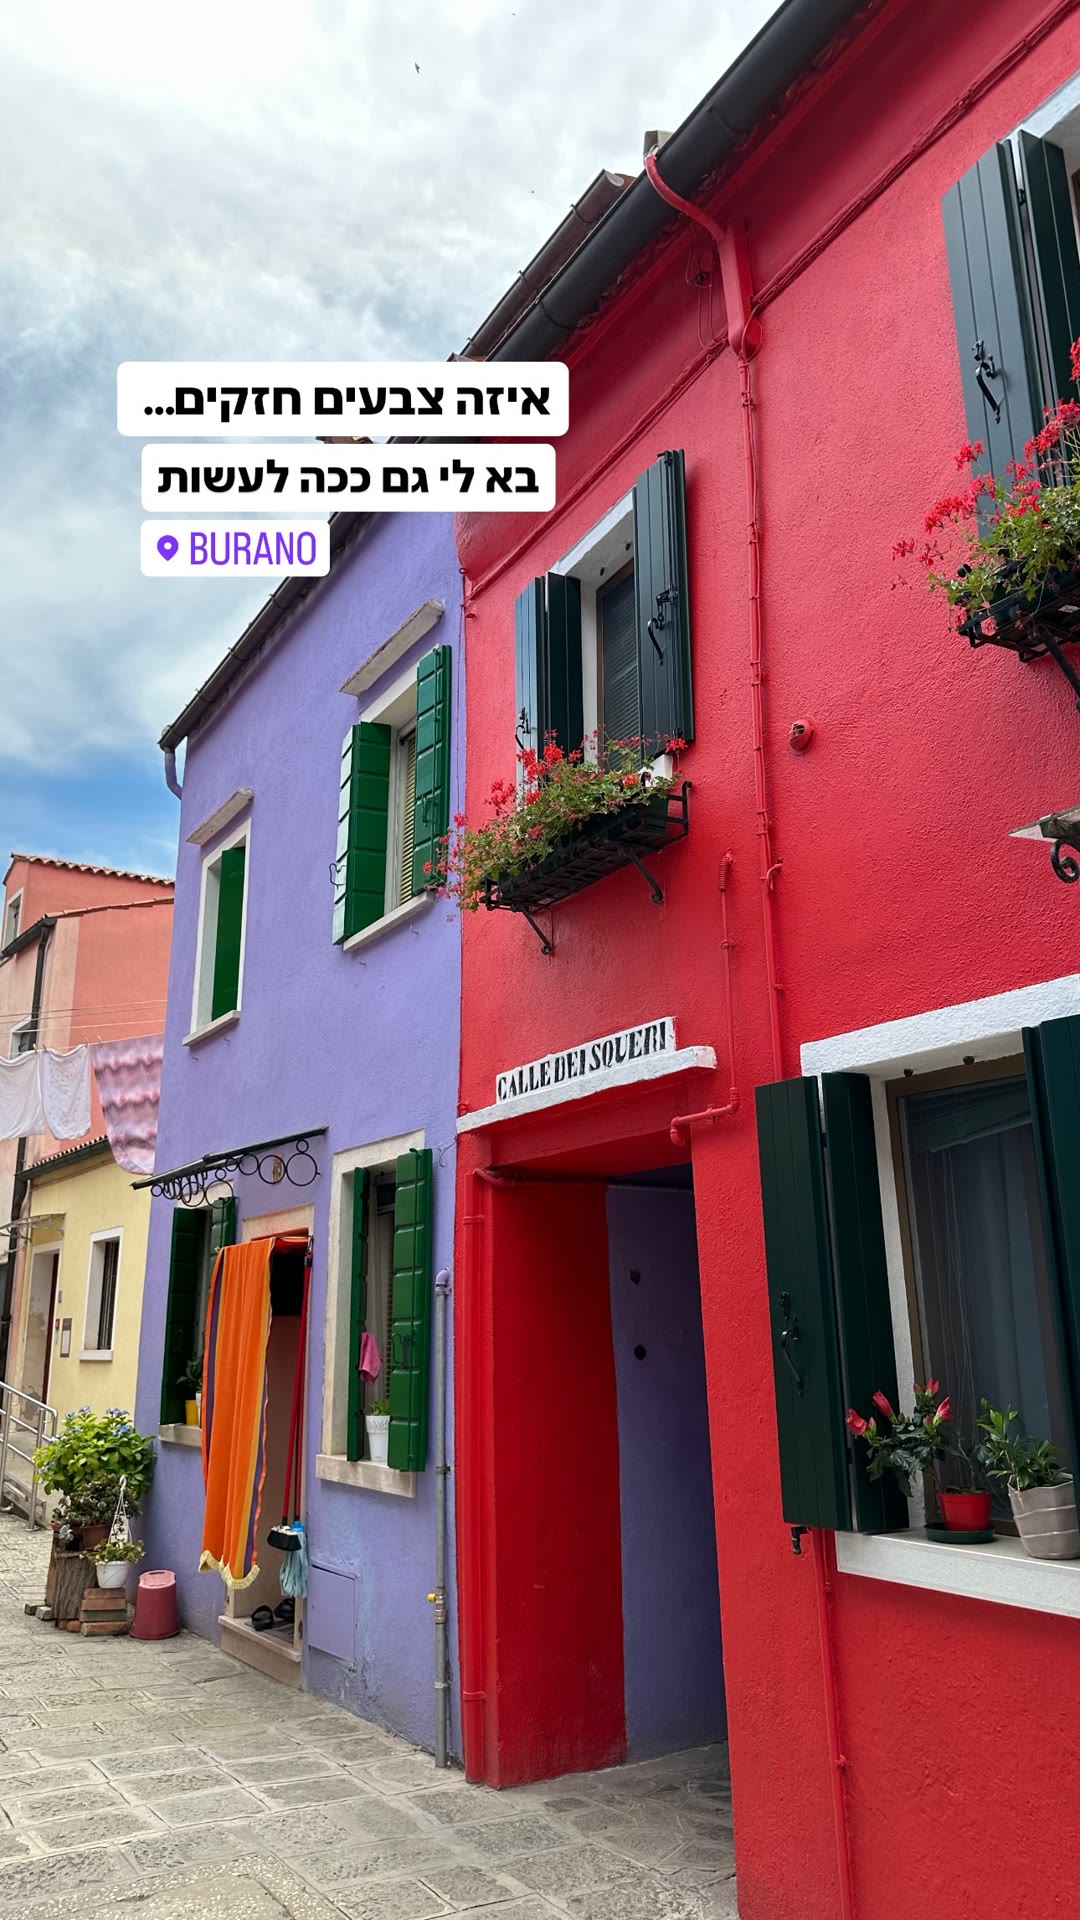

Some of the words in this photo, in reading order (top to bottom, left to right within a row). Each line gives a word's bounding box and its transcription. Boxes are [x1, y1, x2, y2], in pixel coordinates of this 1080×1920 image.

[497, 1060, 551, 1101] CALLE
[554, 1049, 586, 1084] DEI
[589, 1021, 666, 1072] SQUERI
